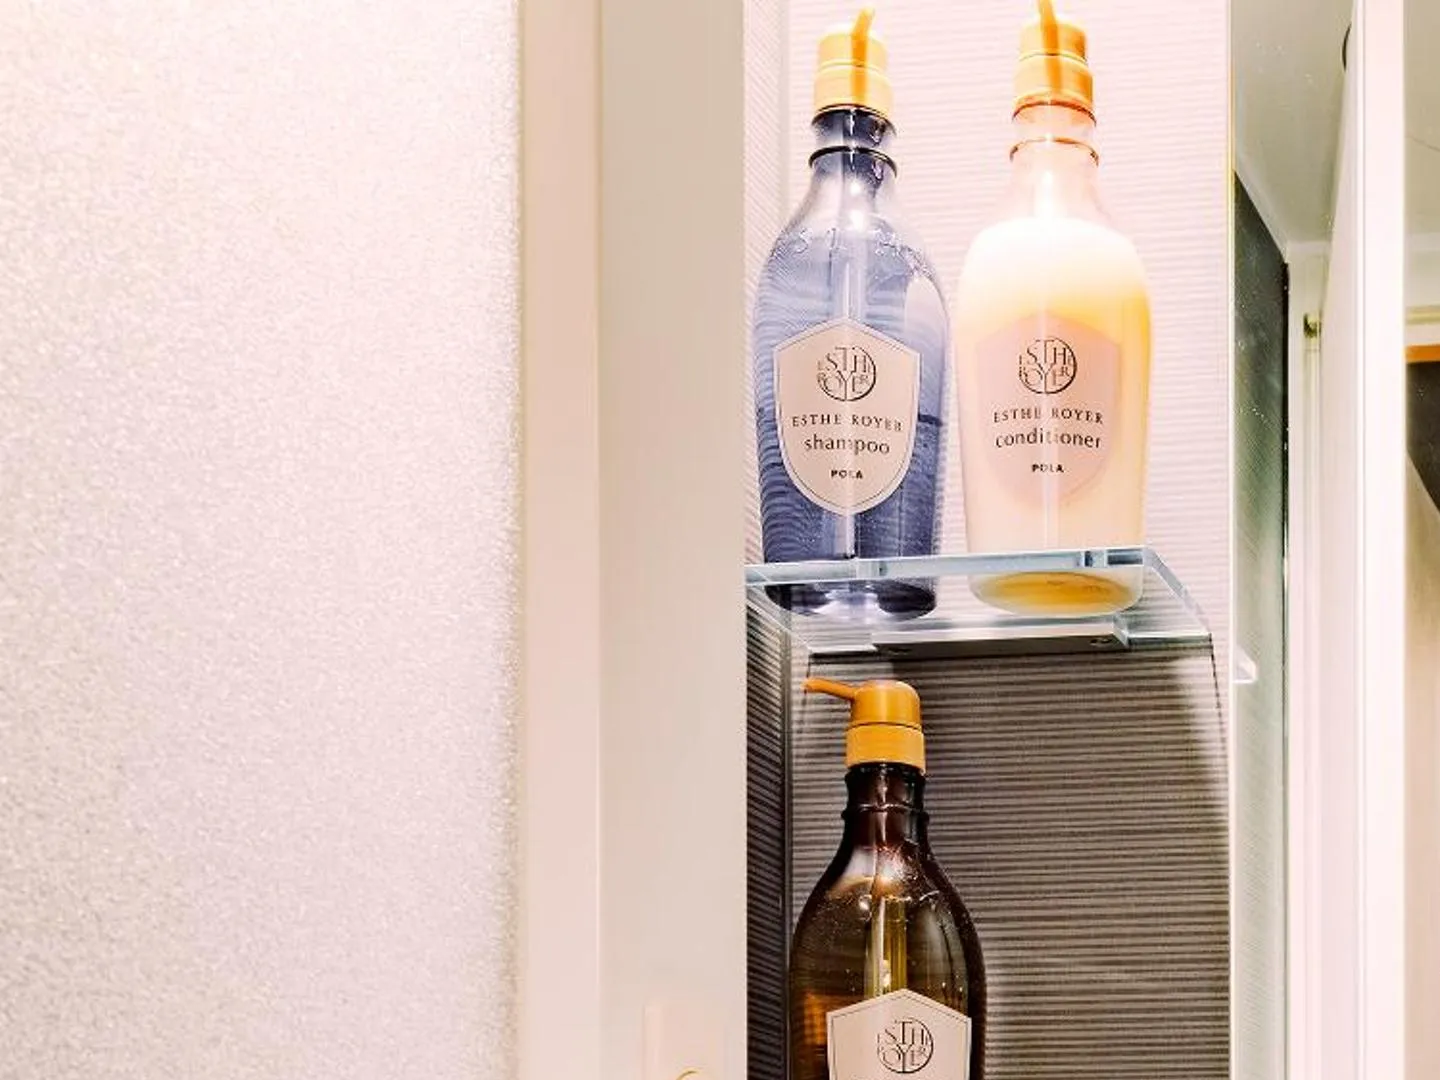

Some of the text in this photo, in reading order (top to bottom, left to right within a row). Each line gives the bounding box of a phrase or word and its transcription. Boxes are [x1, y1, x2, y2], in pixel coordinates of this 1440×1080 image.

[792, 413, 902, 432] ESTHE ROYER
[994, 407, 1103, 425] ESTHE ROYER
[804, 433, 890, 455] shampoo
[995, 427, 1102, 448] conditioner
[830, 469, 864, 480] POLA
[1031, 463, 1065, 473] POLA
